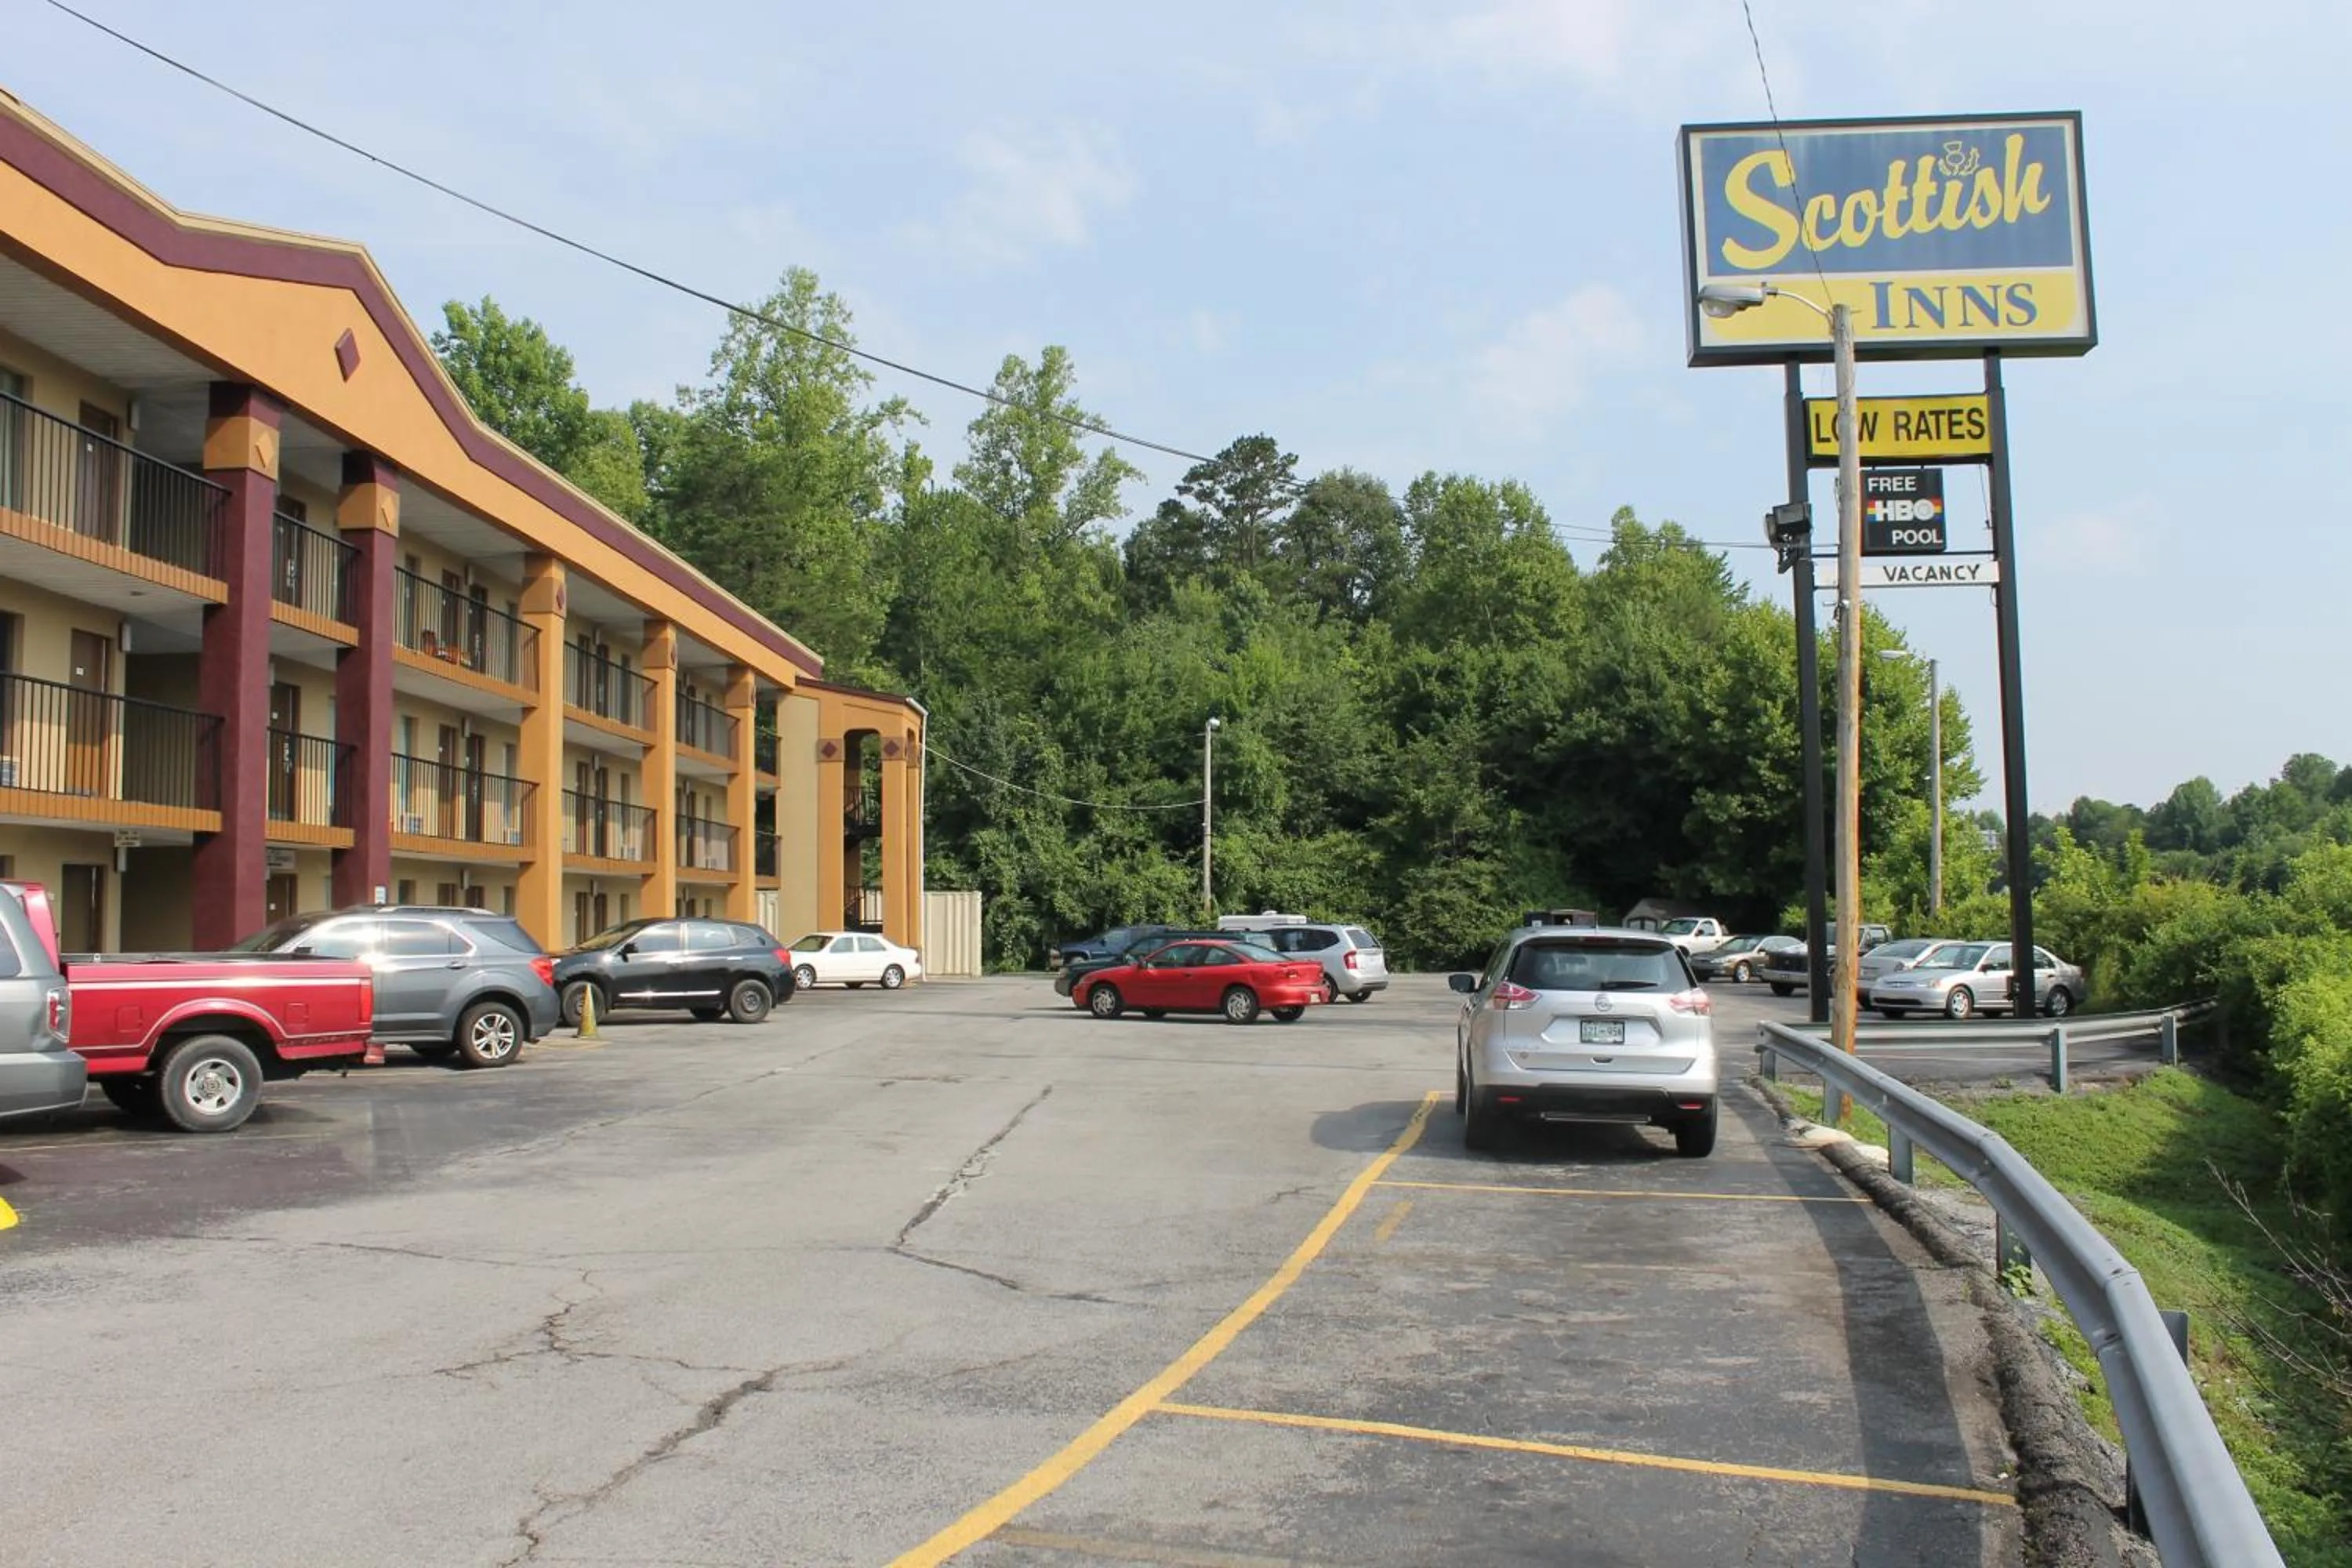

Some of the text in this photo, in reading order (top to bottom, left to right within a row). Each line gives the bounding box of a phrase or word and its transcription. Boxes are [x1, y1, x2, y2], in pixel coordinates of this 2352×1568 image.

[1722, 133, 2050, 270] Scottish
[1869, 281, 2038, 330] INNS
[1893, 408, 1986, 441] RATES
[1867, 476, 1918, 492] FREE
[1875, 499, 1935, 521] HBO
[1892, 528, 1944, 546] POOL
[1883, 564, 1980, 582] VACANCY
